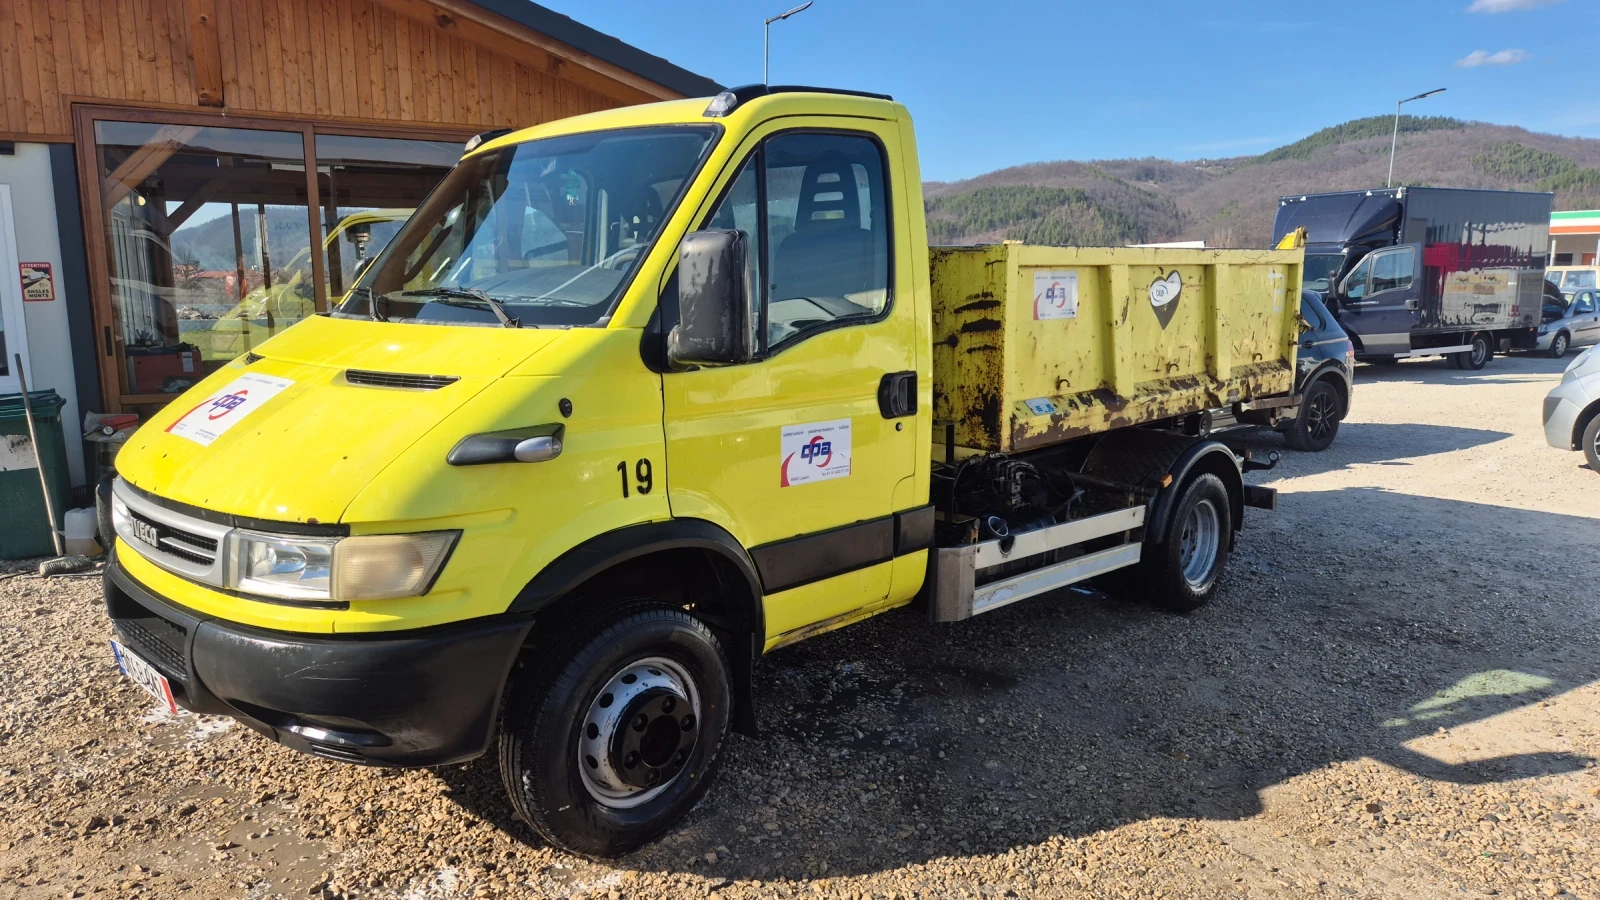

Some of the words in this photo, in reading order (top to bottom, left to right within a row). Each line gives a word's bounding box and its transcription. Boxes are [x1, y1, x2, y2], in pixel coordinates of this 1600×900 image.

[208, 394, 247, 412] cpa
[800, 441, 832, 464] cpa
[617, 458, 652, 498] 19
[131, 517, 158, 547] IVECO
